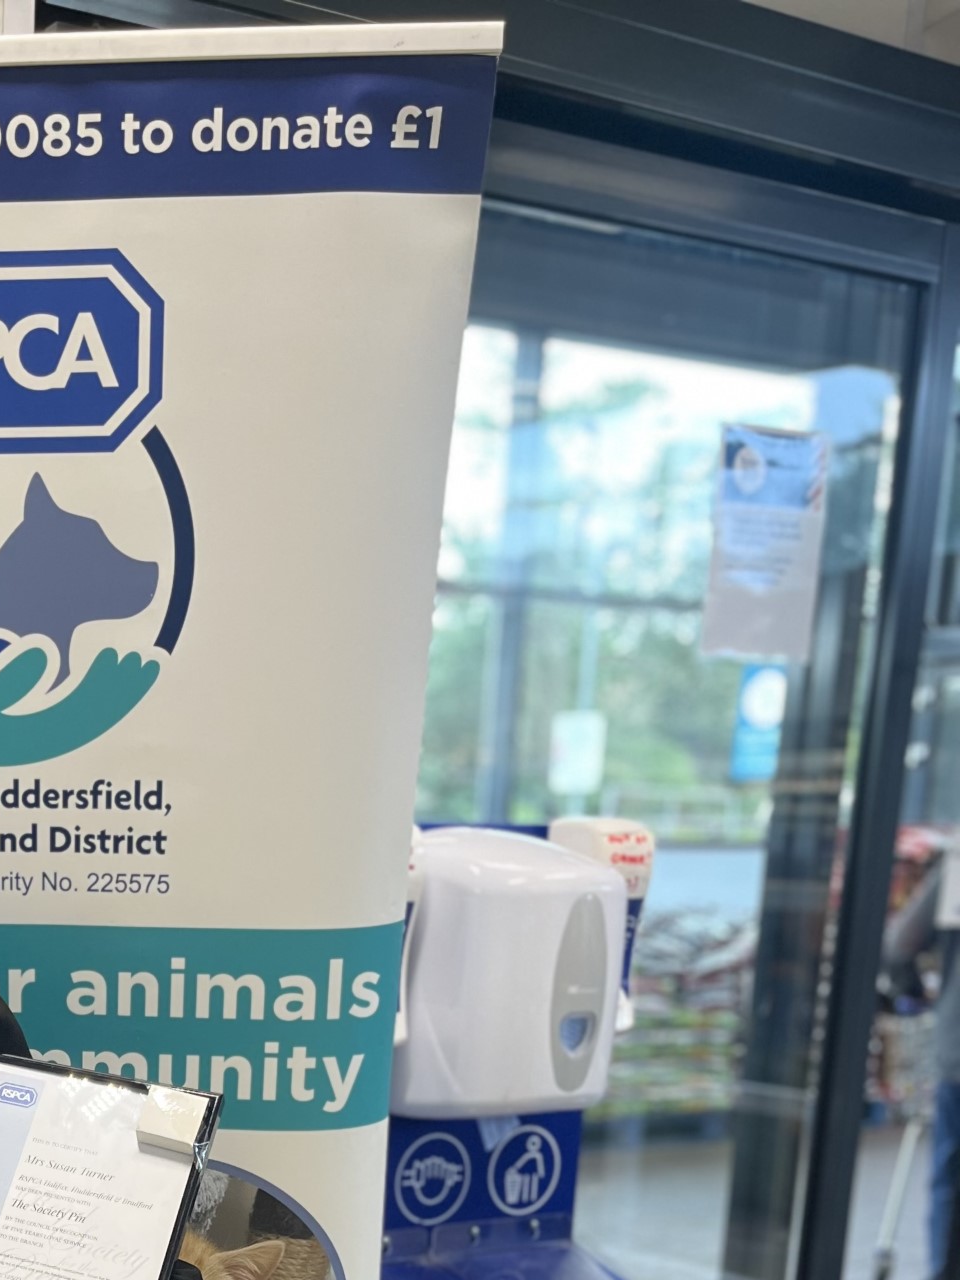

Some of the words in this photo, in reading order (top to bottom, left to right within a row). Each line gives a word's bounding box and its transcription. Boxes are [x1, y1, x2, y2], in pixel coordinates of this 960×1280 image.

[121, 112, 174, 155] to
[190, 107, 373, 153] donate
[389, 105, 444, 150] £1
[48, 826, 168, 856] District
[41, 872, 78, 892] No.
[86, 873, 171, 894] 225575
[66, 957, 381, 1021] animals
[28, 1041, 366, 1113] munity
[1, 1088, 32, 1103] RSPCA
[24, 1155, 44, 1167] Mrs
[46, 1160, 77, 1174] Susan
[81, 1167, 116, 1181] Turner
[11, 1198, 29, 1210] The
[32, 1203, 66, 1220] Society
[68, 1211, 87, 1223] Pin
[122, 1197, 154, 1211] Bradford
